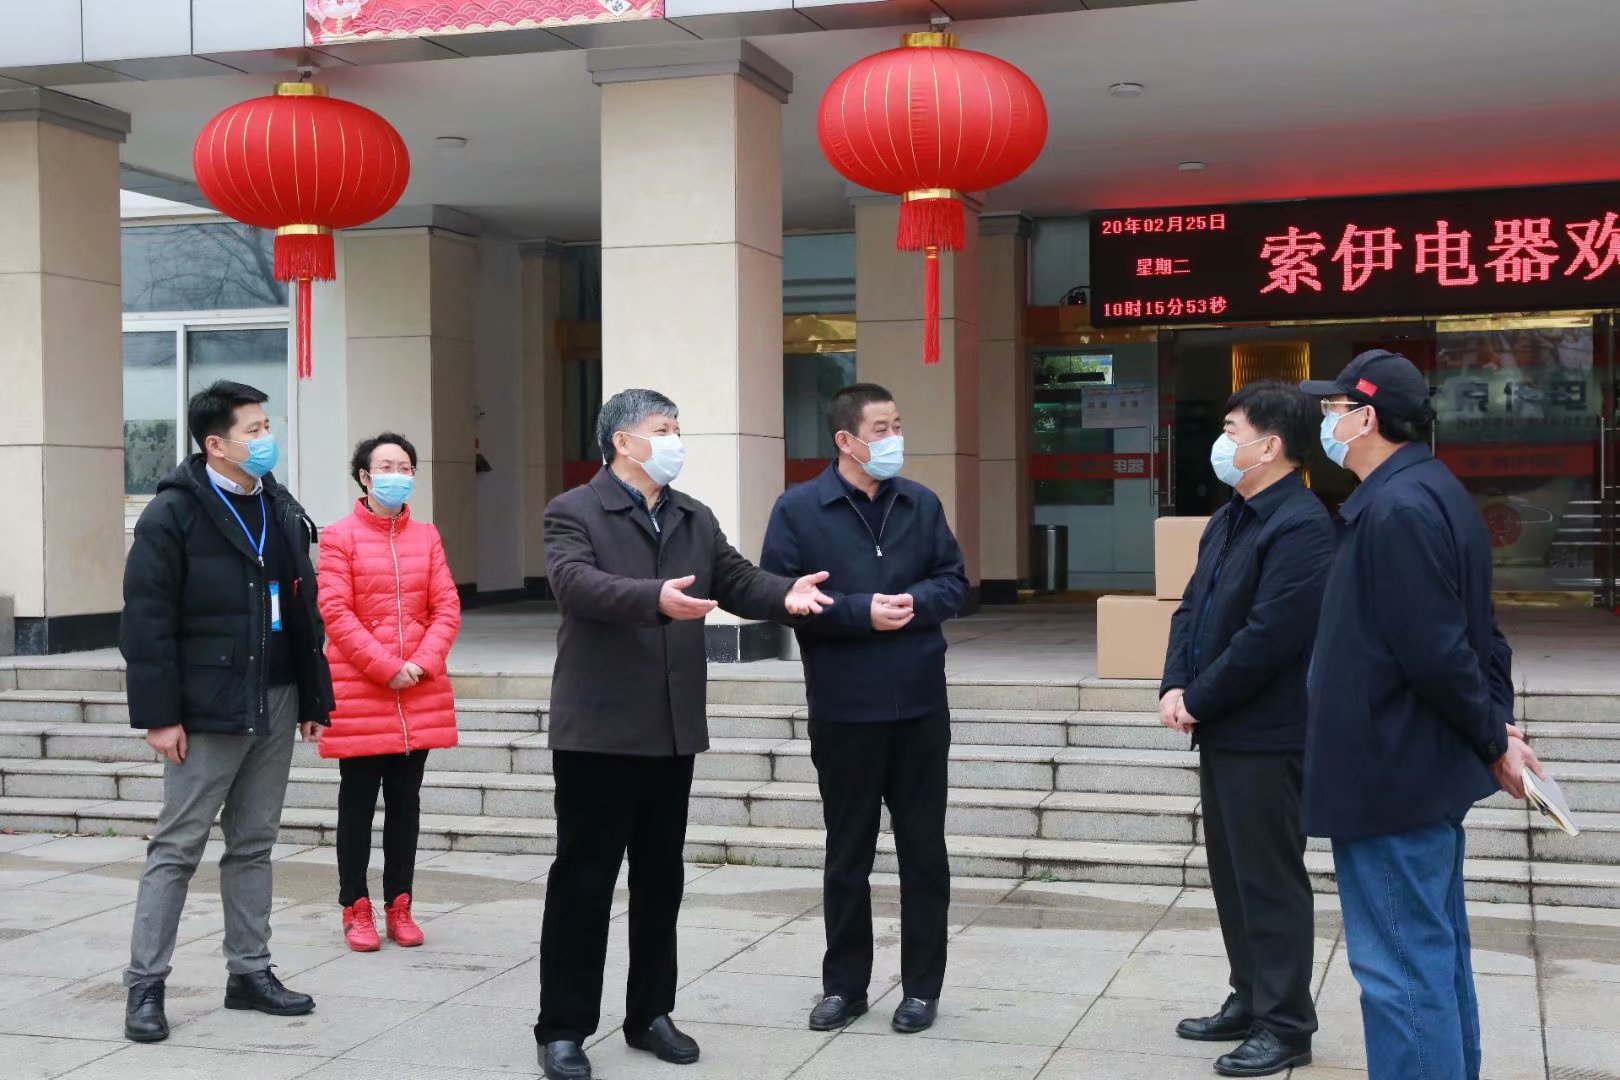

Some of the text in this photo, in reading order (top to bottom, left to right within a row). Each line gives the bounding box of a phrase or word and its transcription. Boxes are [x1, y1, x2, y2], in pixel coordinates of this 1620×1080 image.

[1102, 213, 1226, 234] 20年02月25日
[1260, 211, 1620, 294] 索伊电器欢
[1136, 258, 1191, 276] 星期二
[1104, 296, 1228, 317] 10时15分53秒
